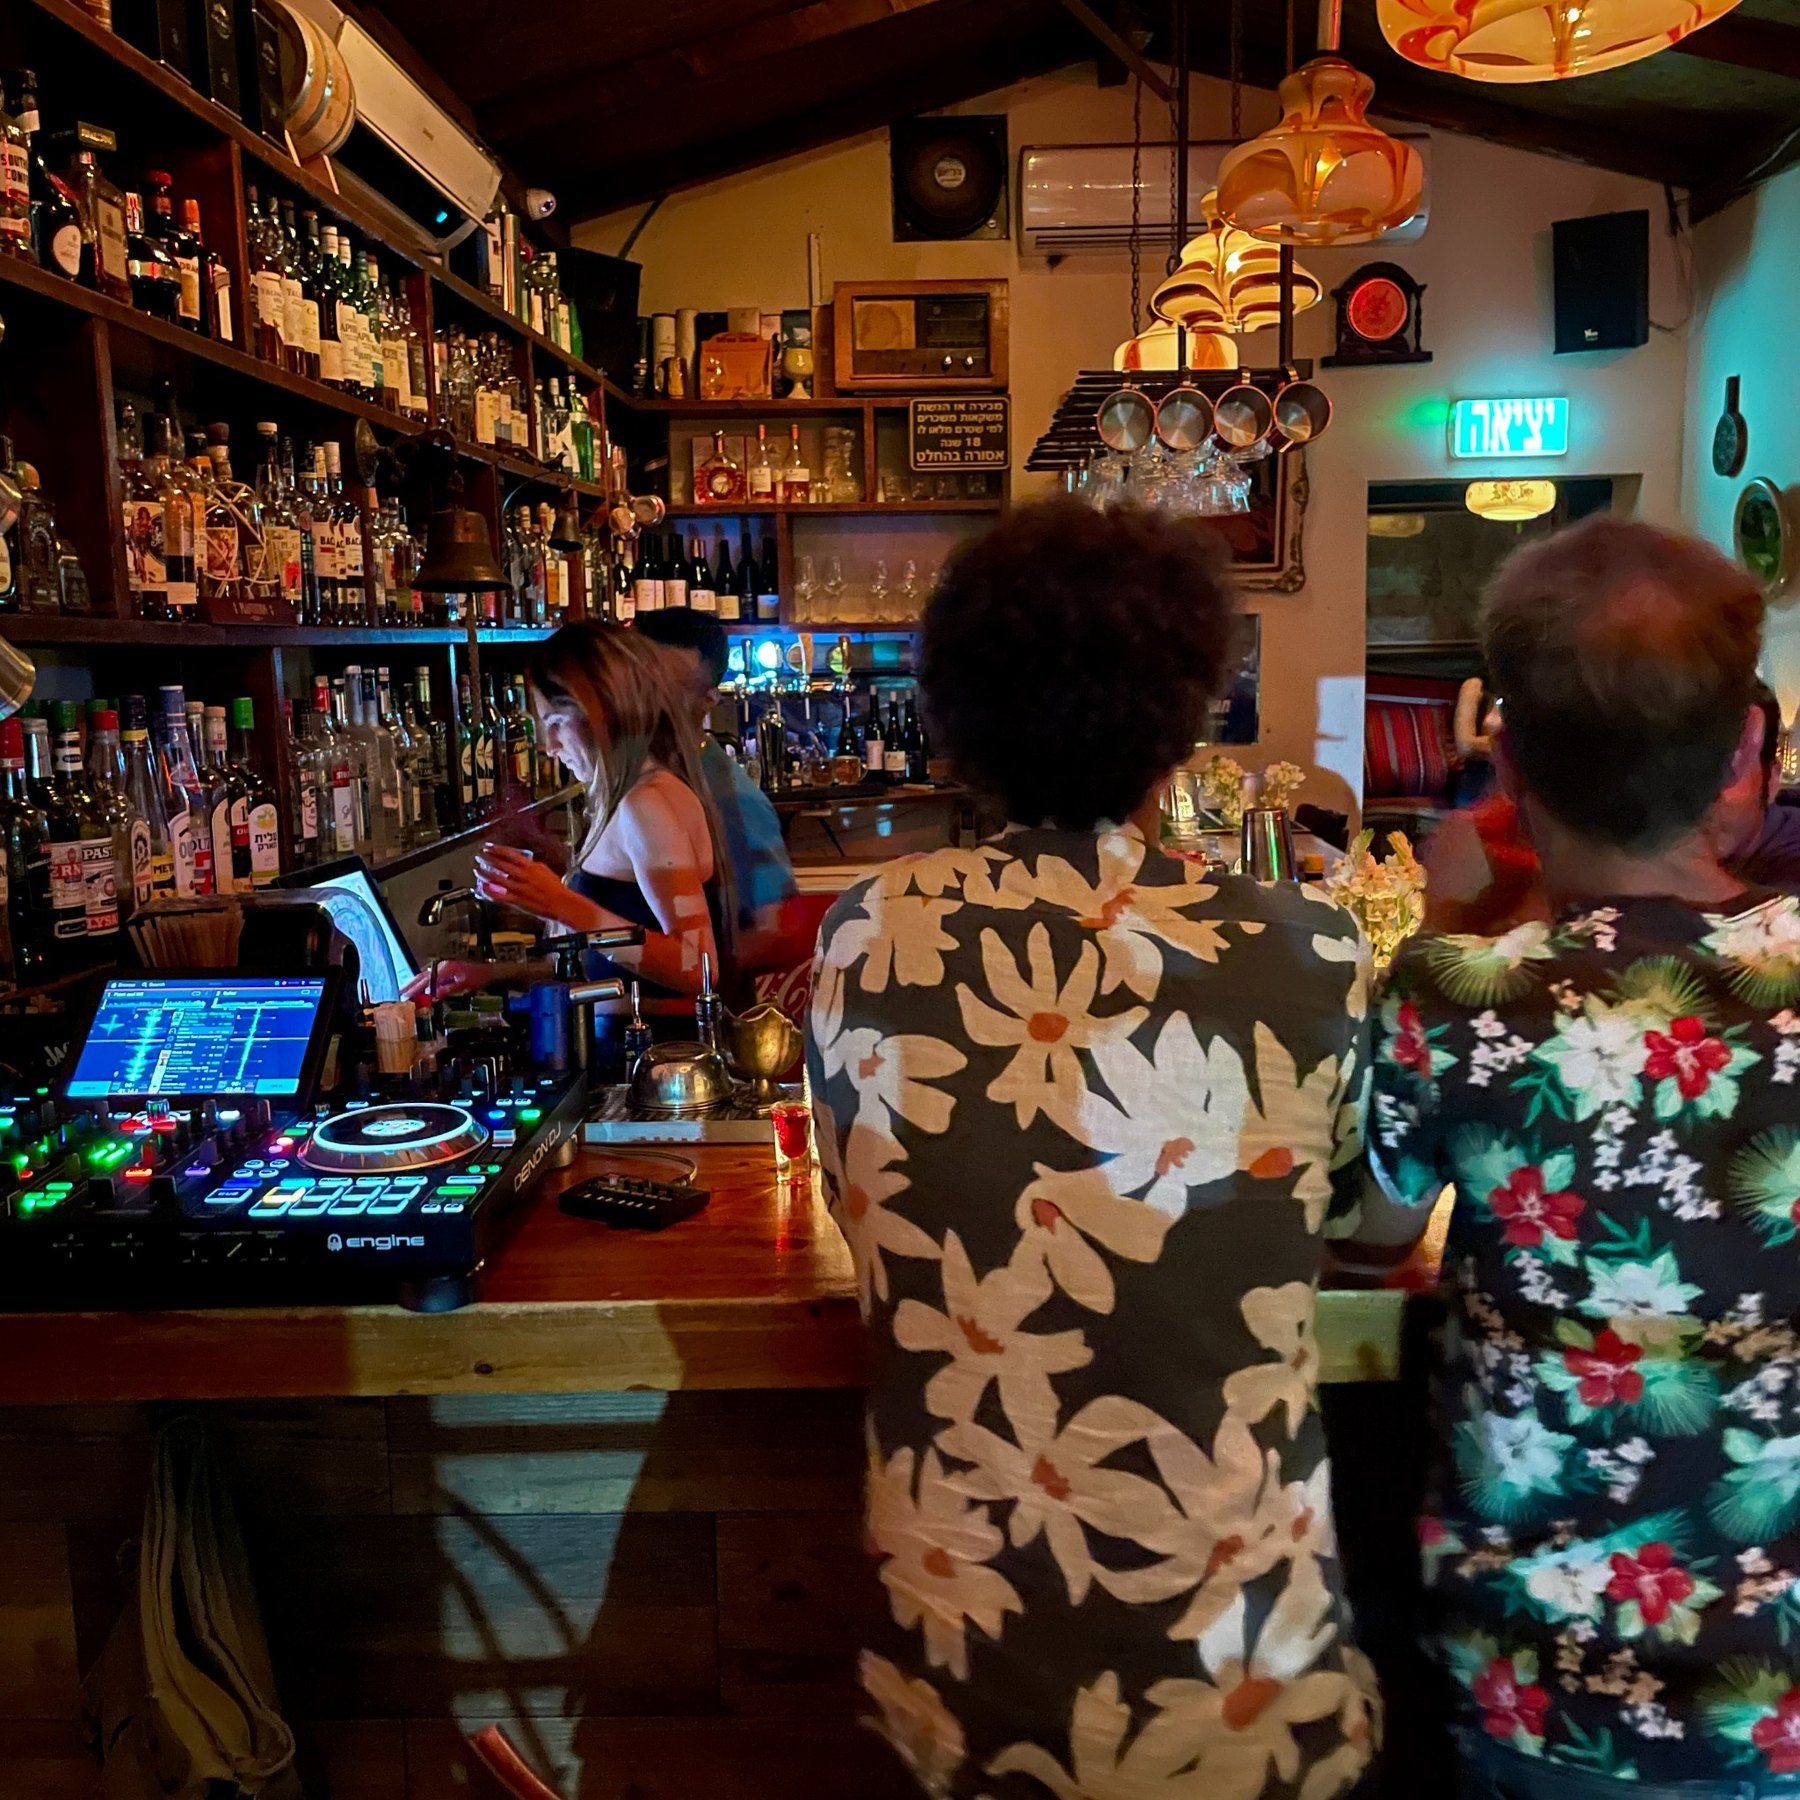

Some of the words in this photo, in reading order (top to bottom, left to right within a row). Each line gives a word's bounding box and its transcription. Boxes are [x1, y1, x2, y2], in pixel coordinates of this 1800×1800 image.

[917, 403, 951, 412] הגשת
[954, 403, 966, 411] או
[969, 402, 1003, 411] מכירה
[917, 414, 957, 423] משכרים
[960, 413, 1003, 423] משקאות
[917, 425, 927, 434] לו
[929, 425, 952, 434] מלאו
[955, 425, 984, 434] שטרם
[986, 424, 1003, 433] למי
[1470, 400, 1555, 451] יציאה
[940, 439, 962, 447] שנה
[966, 437, 981, 447] 18
[916, 449, 960, 462] בהחלט
[965, 450, 1005, 461] אסורה
[514, 1137, 548, 1193] DENON
[549, 1121, 562, 1147] DJ
[346, 1234, 425, 1250] engine
